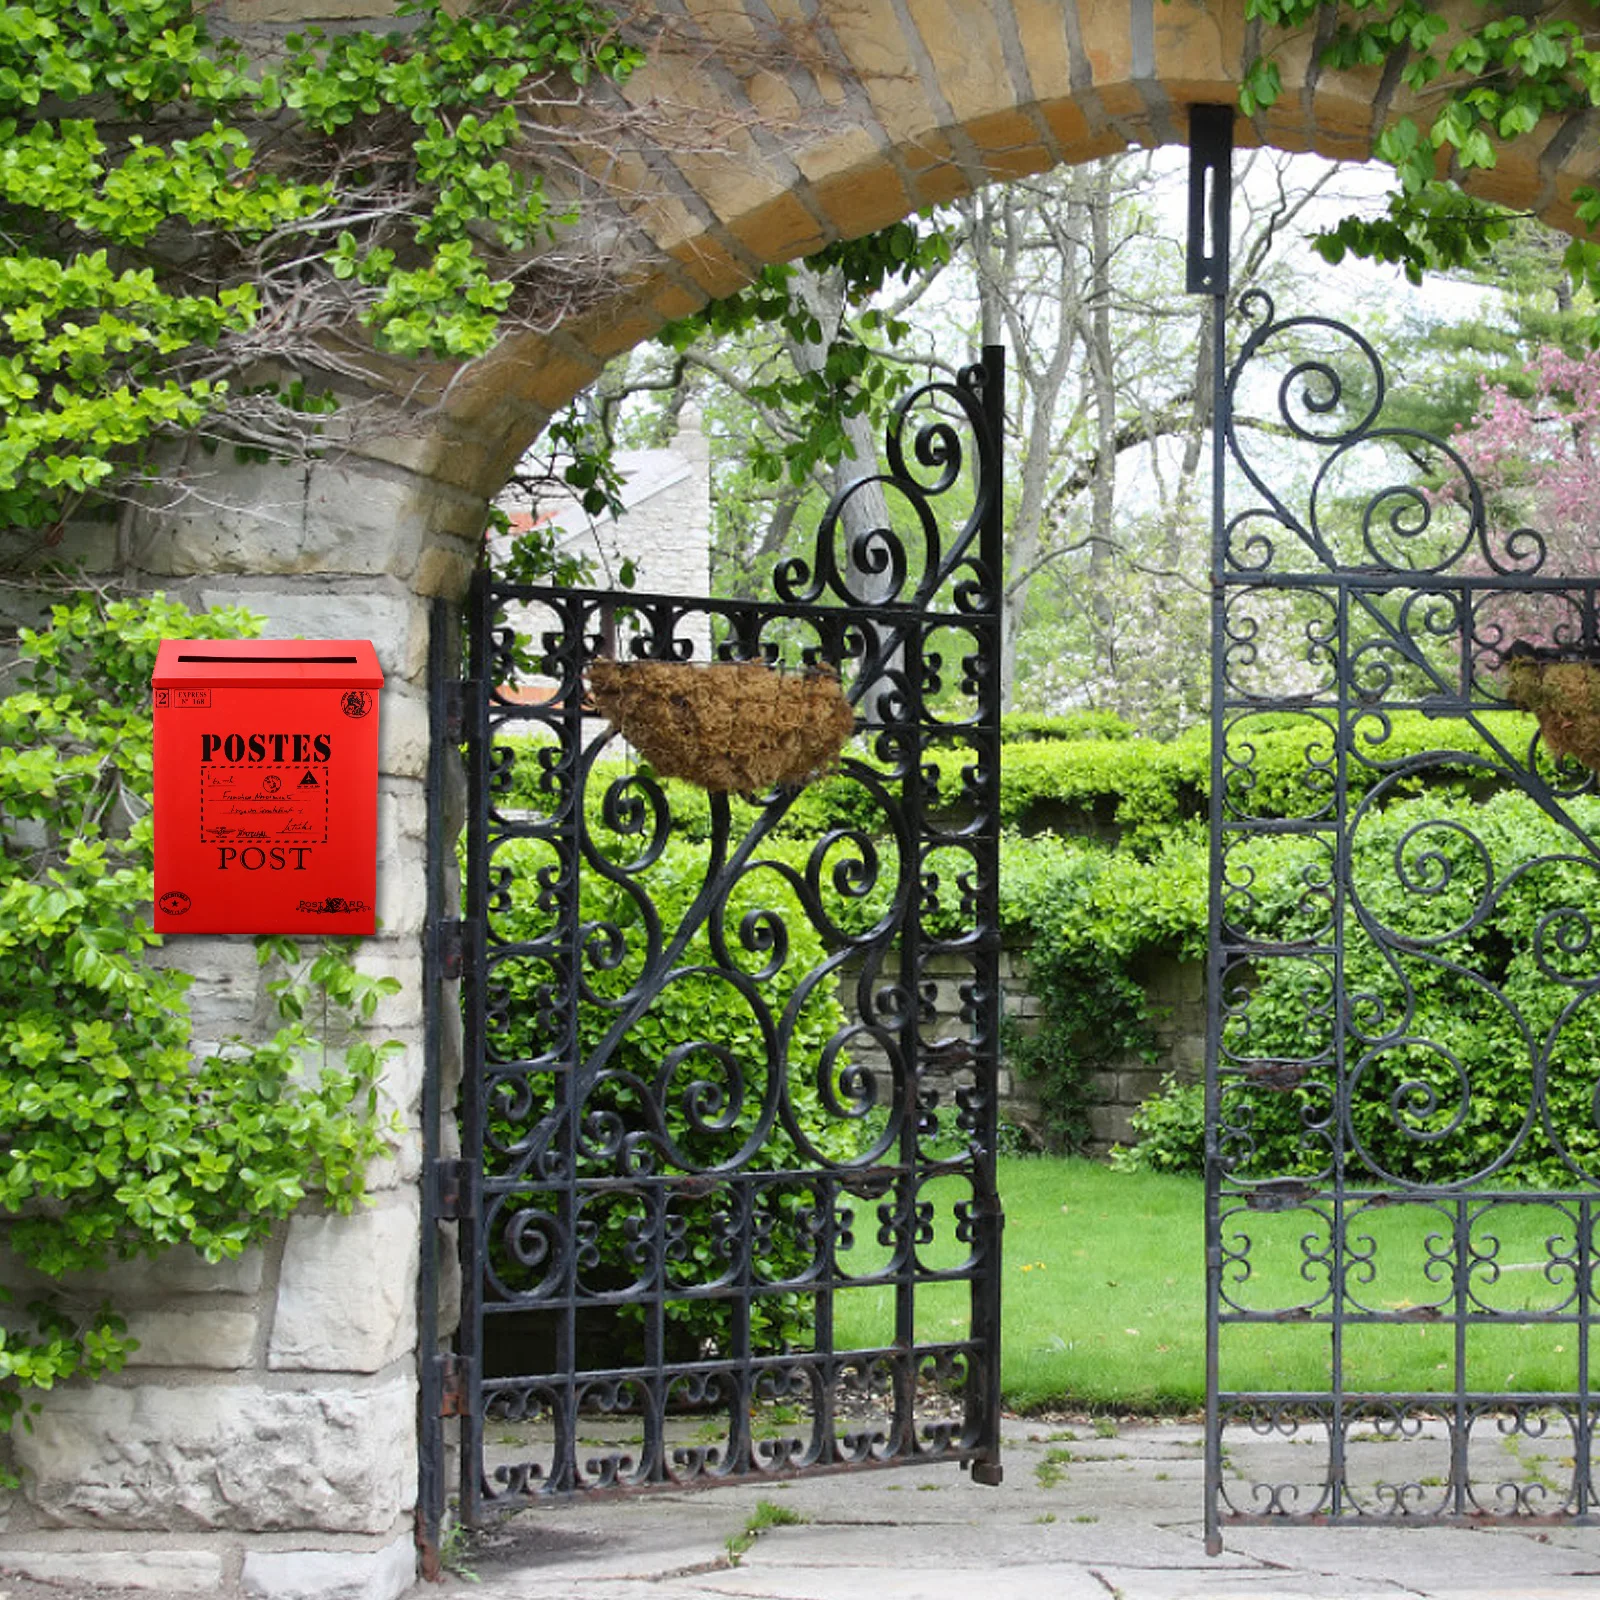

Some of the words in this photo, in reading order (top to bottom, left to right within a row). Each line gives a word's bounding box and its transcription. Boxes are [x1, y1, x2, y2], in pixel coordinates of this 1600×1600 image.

[158, 692, 167, 705] 2
[201, 733, 331, 762] POSTES
[217, 846, 312, 870] POST
